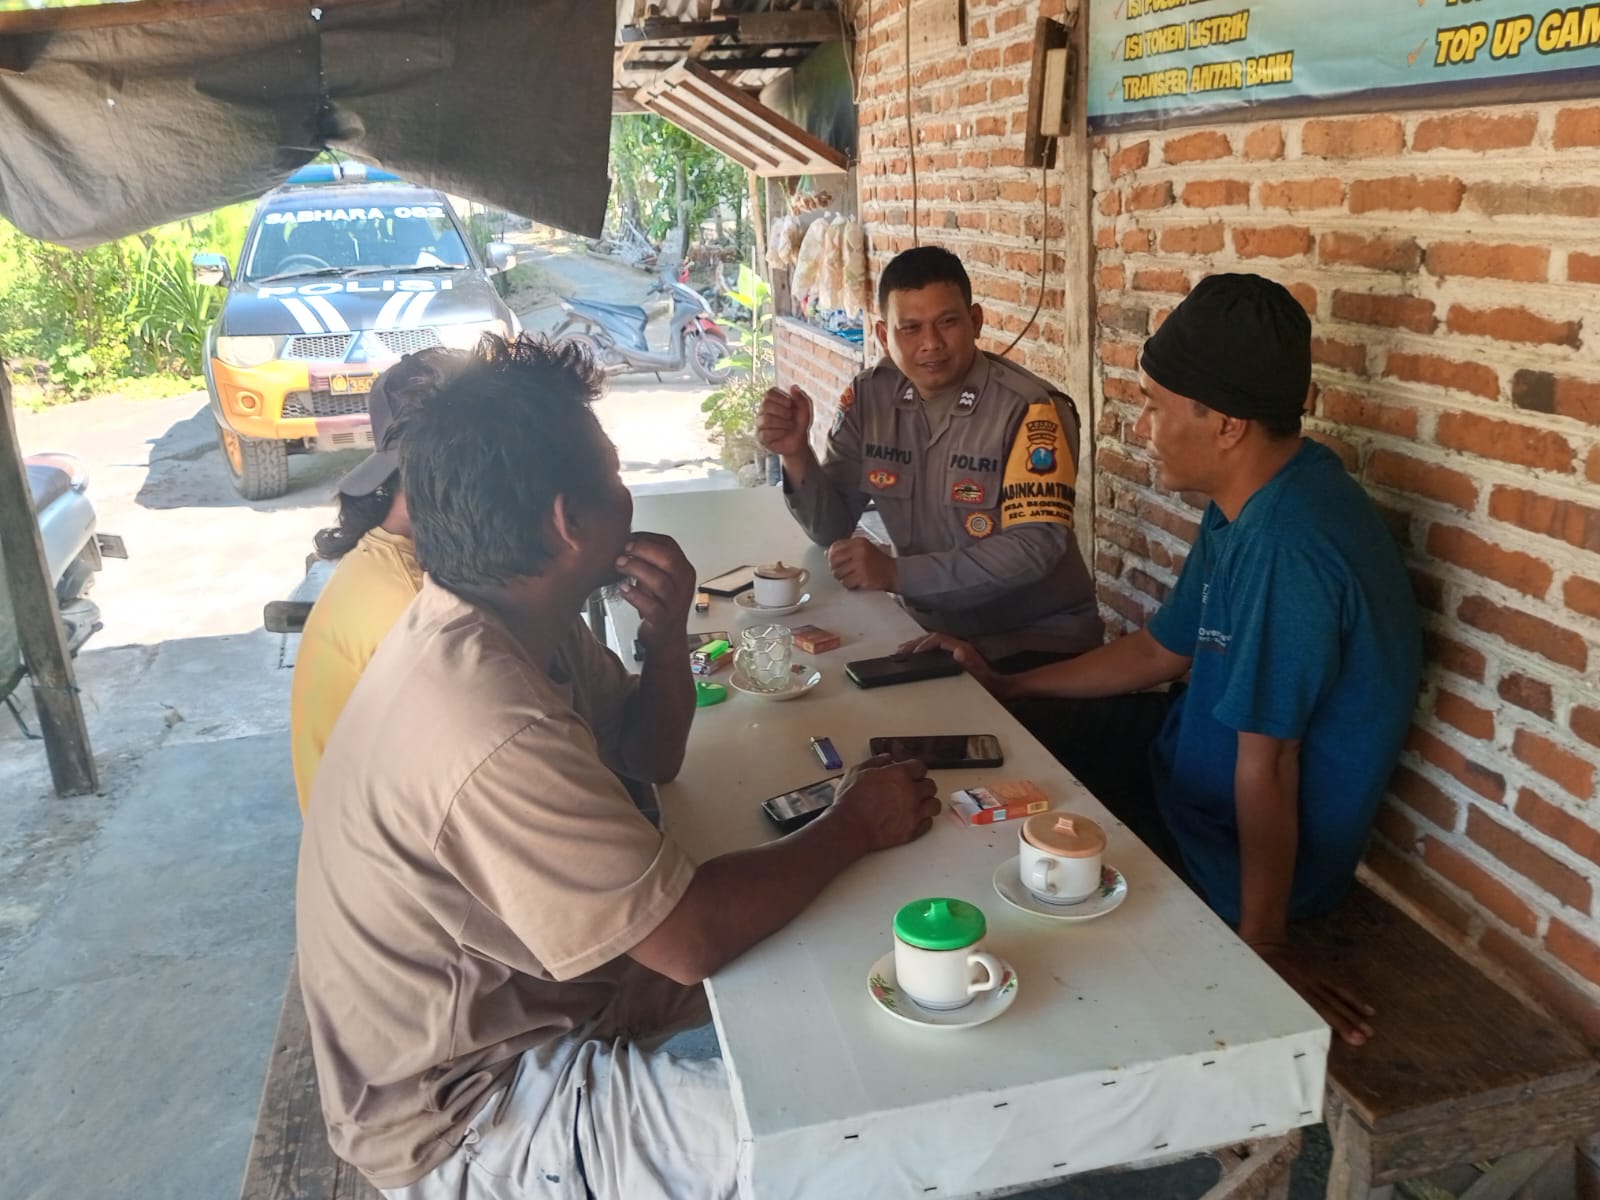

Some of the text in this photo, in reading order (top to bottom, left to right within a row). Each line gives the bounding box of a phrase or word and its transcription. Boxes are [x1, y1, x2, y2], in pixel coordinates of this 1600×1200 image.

[1124, 9, 1250, 61] ISI TOKEN LISTRIK
[1434, 22, 1489, 67] TOP
[1491, 14, 1534, 60] UP
[1122, 51, 1294, 102] TRANSFER ANTAR BANK
[265, 208, 384, 224] SABHARA
[257, 279, 453, 299] POLISI
[865, 443, 912, 465] WAHYU
[950, 454, 997, 473] POLRI
